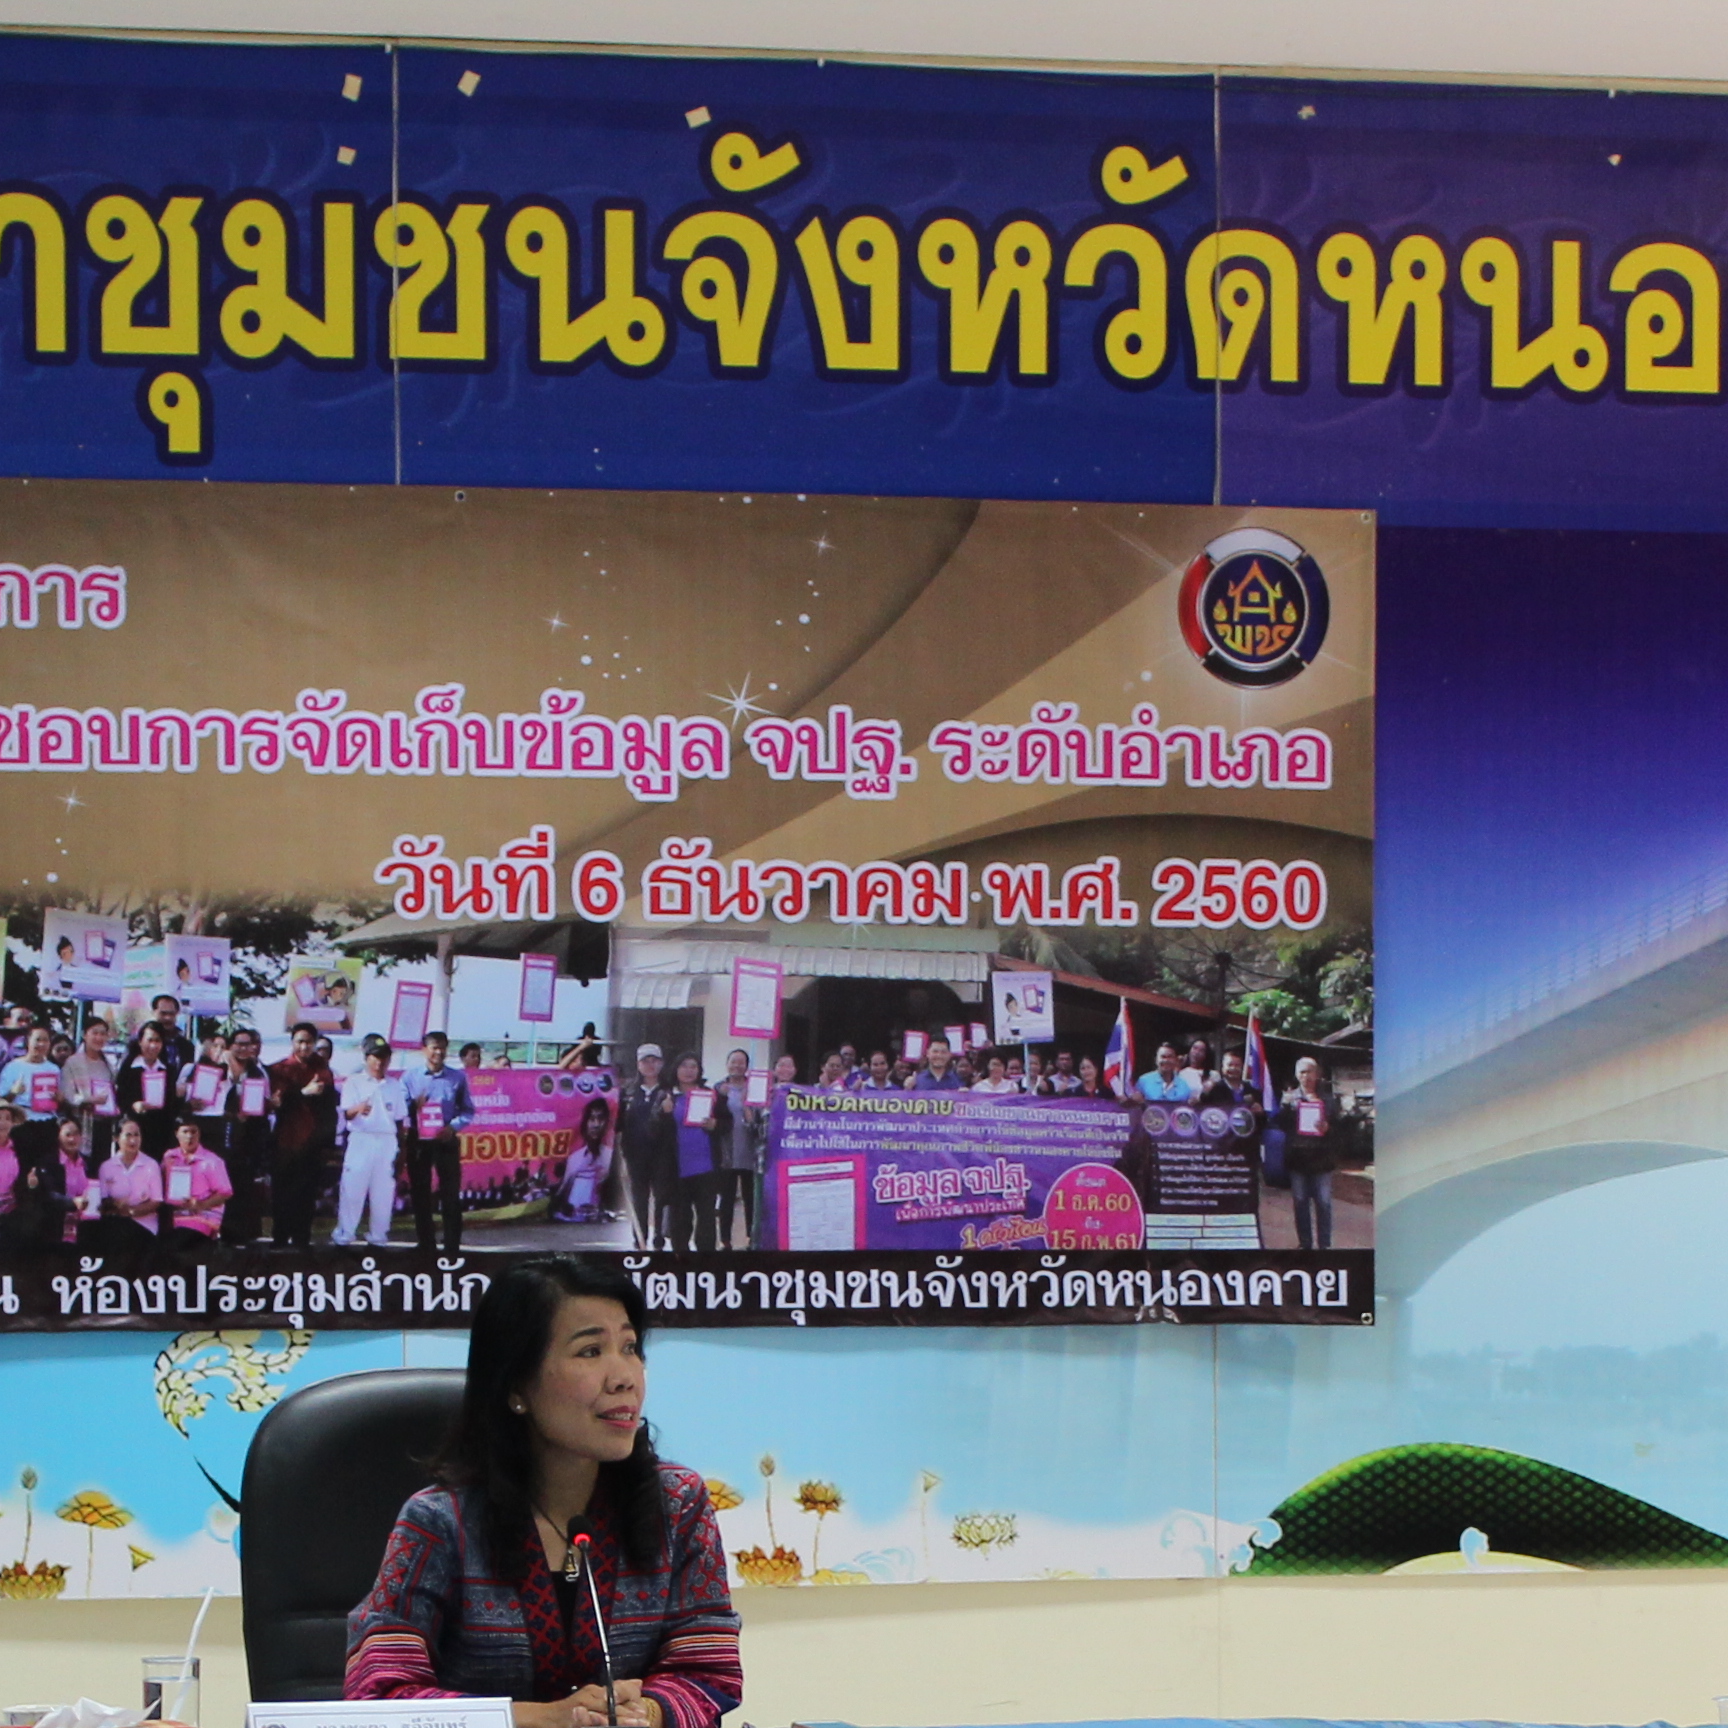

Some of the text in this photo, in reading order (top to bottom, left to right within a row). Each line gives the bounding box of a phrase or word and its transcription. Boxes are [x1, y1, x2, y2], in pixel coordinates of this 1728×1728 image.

[745, 703, 918, 798] จปฐ.
[930, 698, 1333, 792] ระดับอำเภอ
[376, 825, 1327, 930] วันที่ 6 ธันวาคม พ.ศ. 2560
